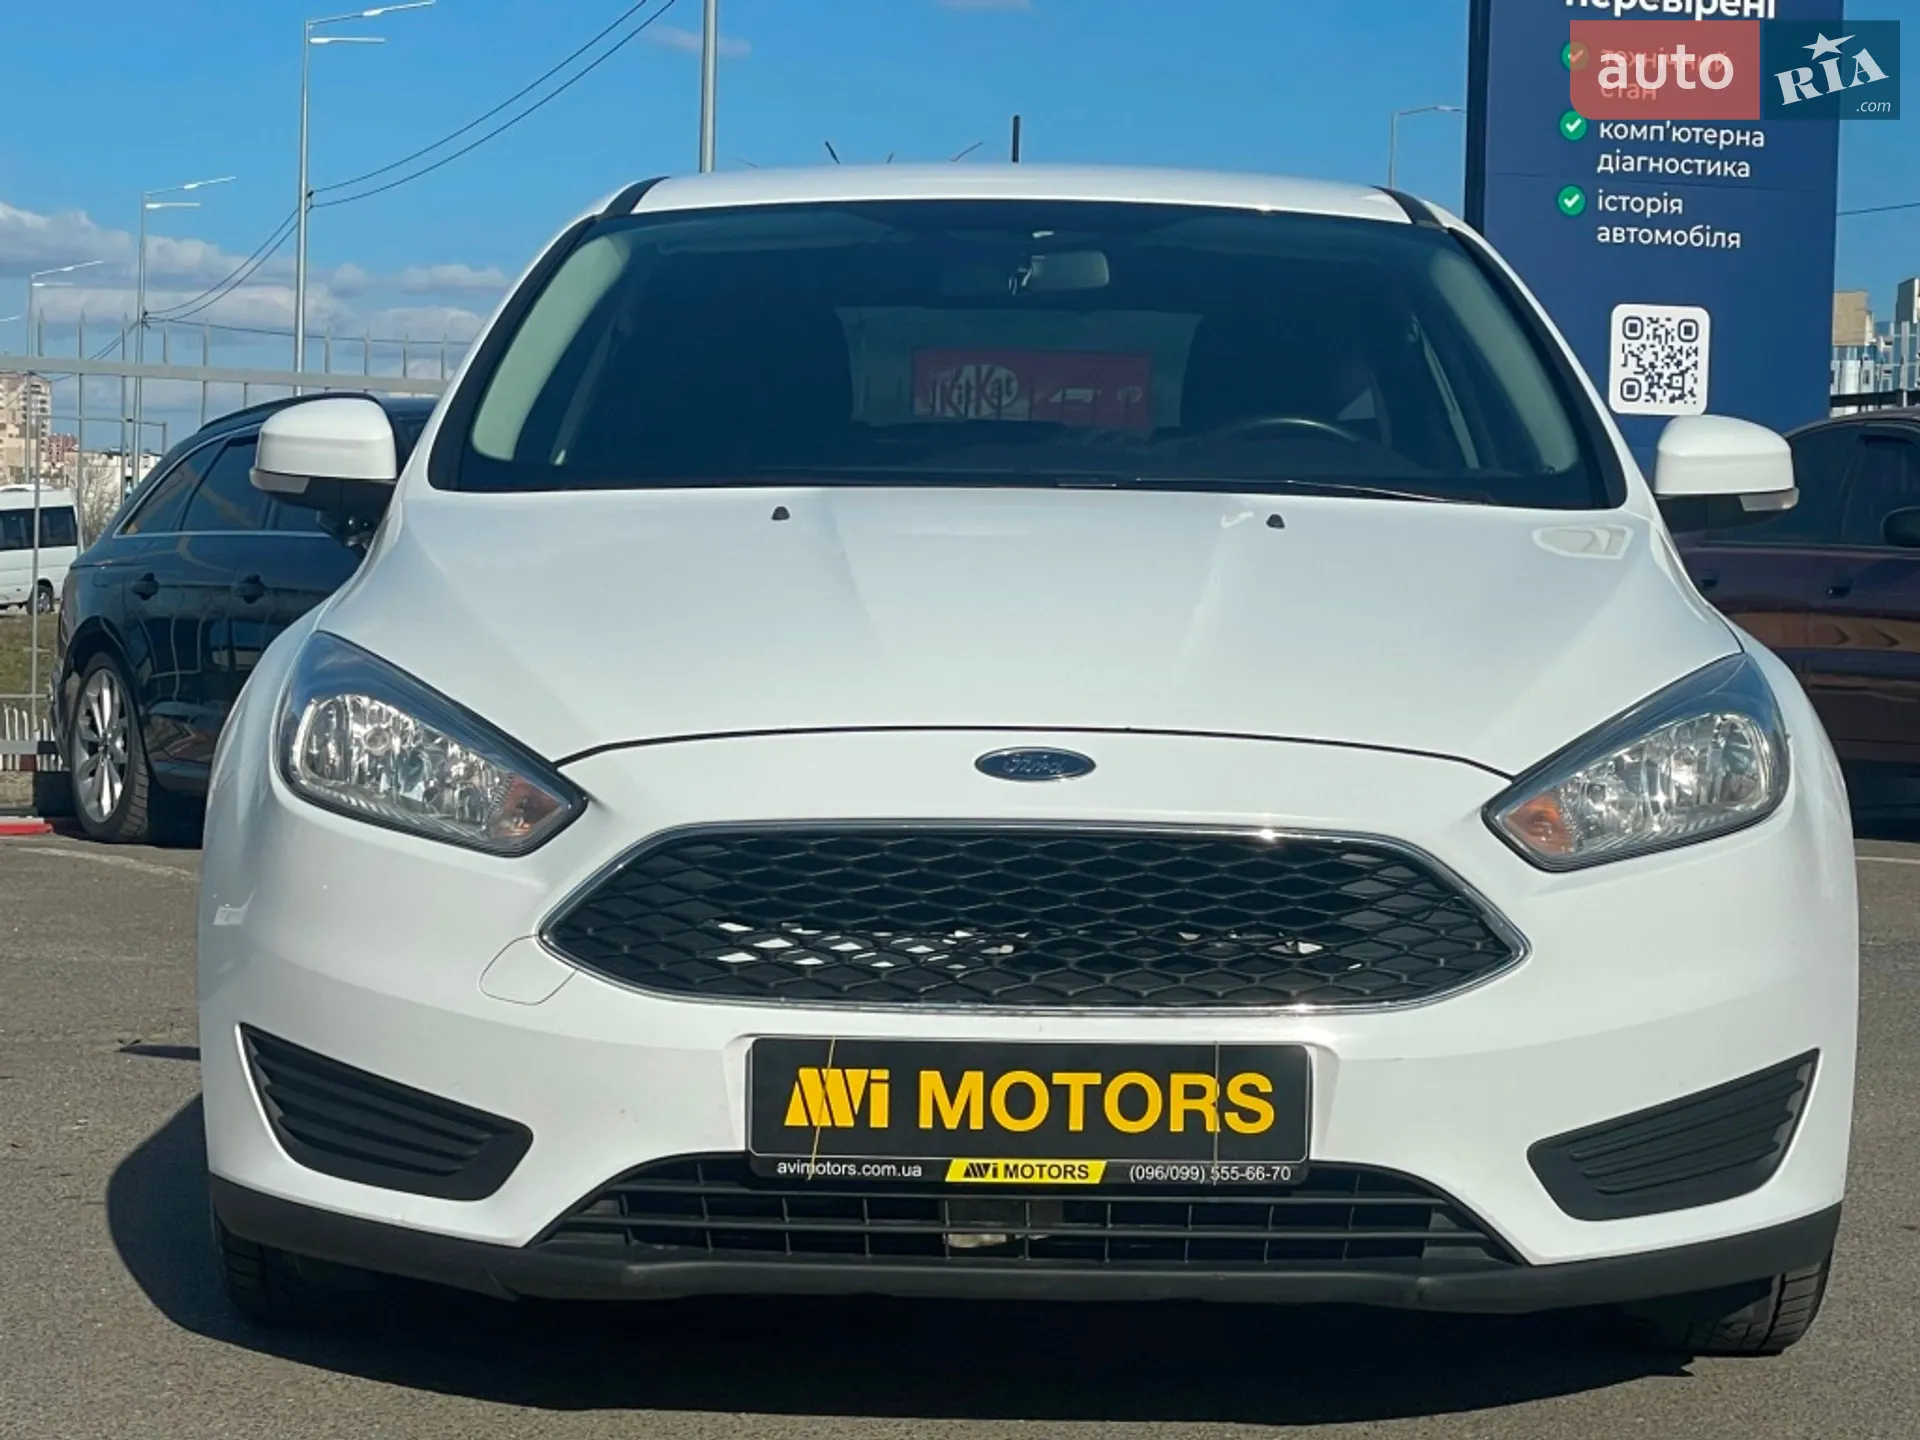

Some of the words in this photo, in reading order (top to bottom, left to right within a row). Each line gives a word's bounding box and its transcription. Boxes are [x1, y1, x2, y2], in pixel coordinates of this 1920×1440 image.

[1600, 120, 1765, 150] комп'ютерна
[1597, 149, 1751, 178] діагностика
[1598, 189, 1684, 219] історія
[1597, 225, 1742, 249] автомобіля
[918, 1070, 1276, 1134] MOTORS
[776, 1160, 922, 1178] avimotors.com.ua
[1003, 1163, 1089, 1180] MOTORS
[1129, 1164, 1206, 1183] (096/099)
[1210, 1166, 1291, 1181] 555-66-70
